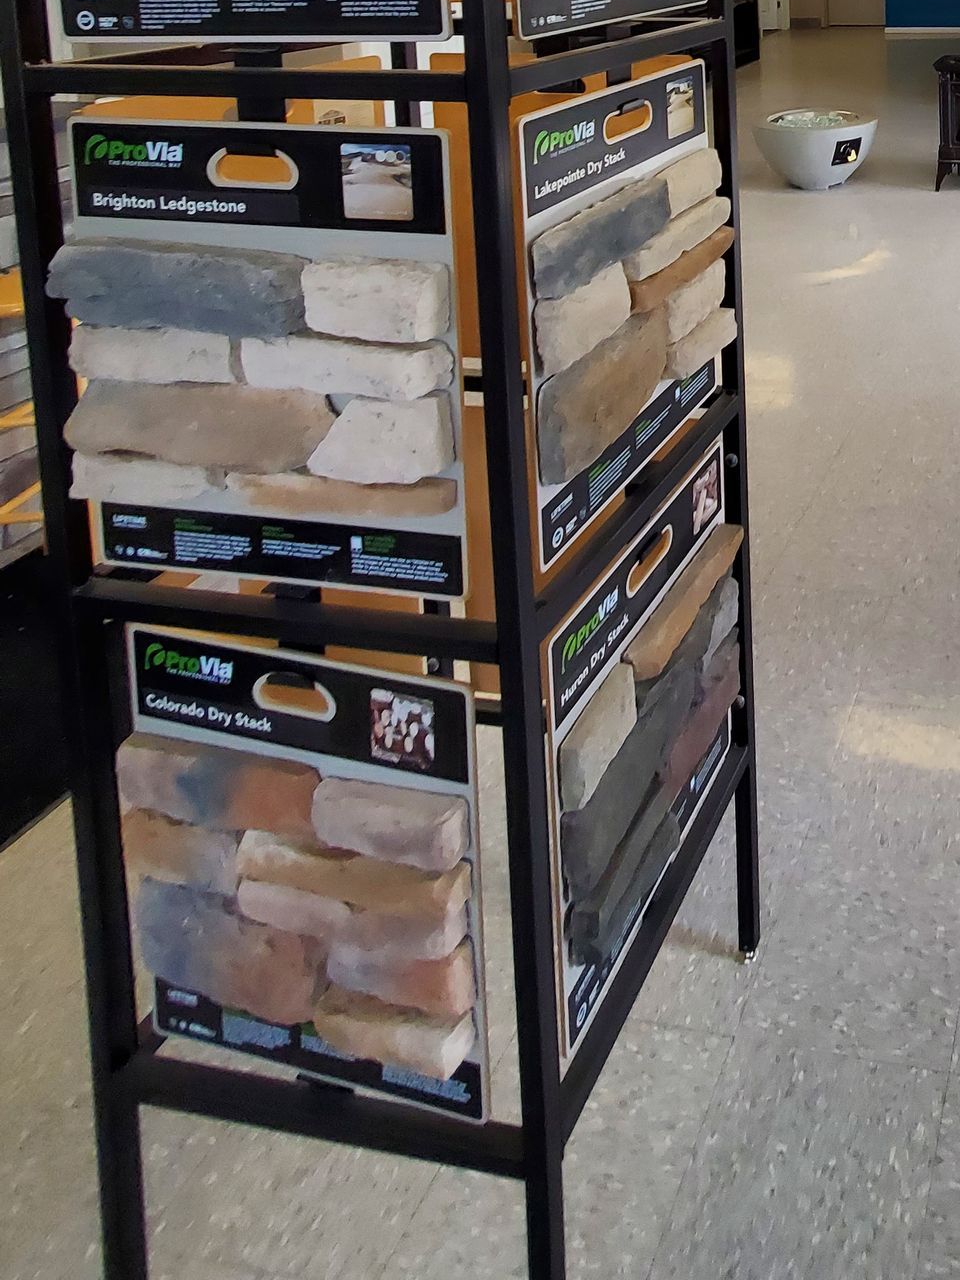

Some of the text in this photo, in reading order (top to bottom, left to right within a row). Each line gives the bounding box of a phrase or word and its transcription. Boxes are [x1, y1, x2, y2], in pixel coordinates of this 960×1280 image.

[108, 140, 183, 162] ProVia
[549, 121, 595, 152] ProVia
[534, 147, 626, 200] Lakepointe Dry Stack
[92, 193, 247, 215] Brighton Ledgestone
[577, 588, 619, 649] ProVia
[166, 651, 233, 678] ProVia
[560, 666, 589, 707] Huron
[590, 643, 606, 669] Dry
[607, 613, 629, 647] Stack
[146, 693, 272, 733] Colorado Dry Stack
